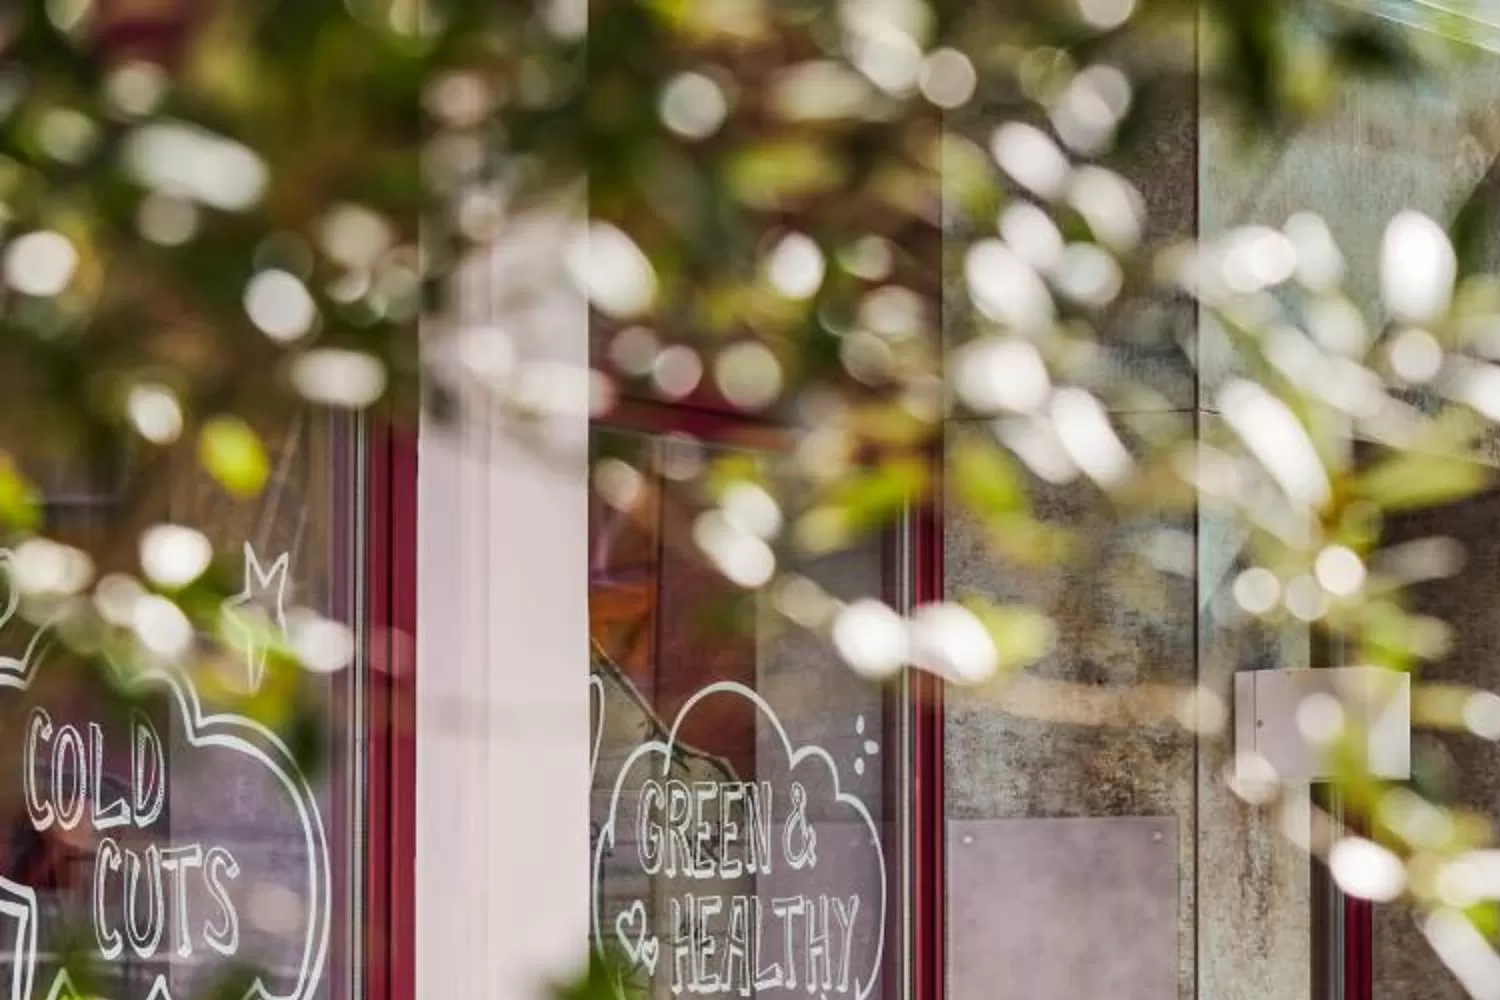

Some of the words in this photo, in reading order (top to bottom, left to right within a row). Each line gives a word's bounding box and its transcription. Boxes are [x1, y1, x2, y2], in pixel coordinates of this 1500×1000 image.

[24, 706, 165, 831] COLD
[637, 779, 773, 880] GREEN
[782, 781, 818, 870] &
[93, 837, 241, 960] CUTS
[671, 893, 860, 997] HEALTHY
